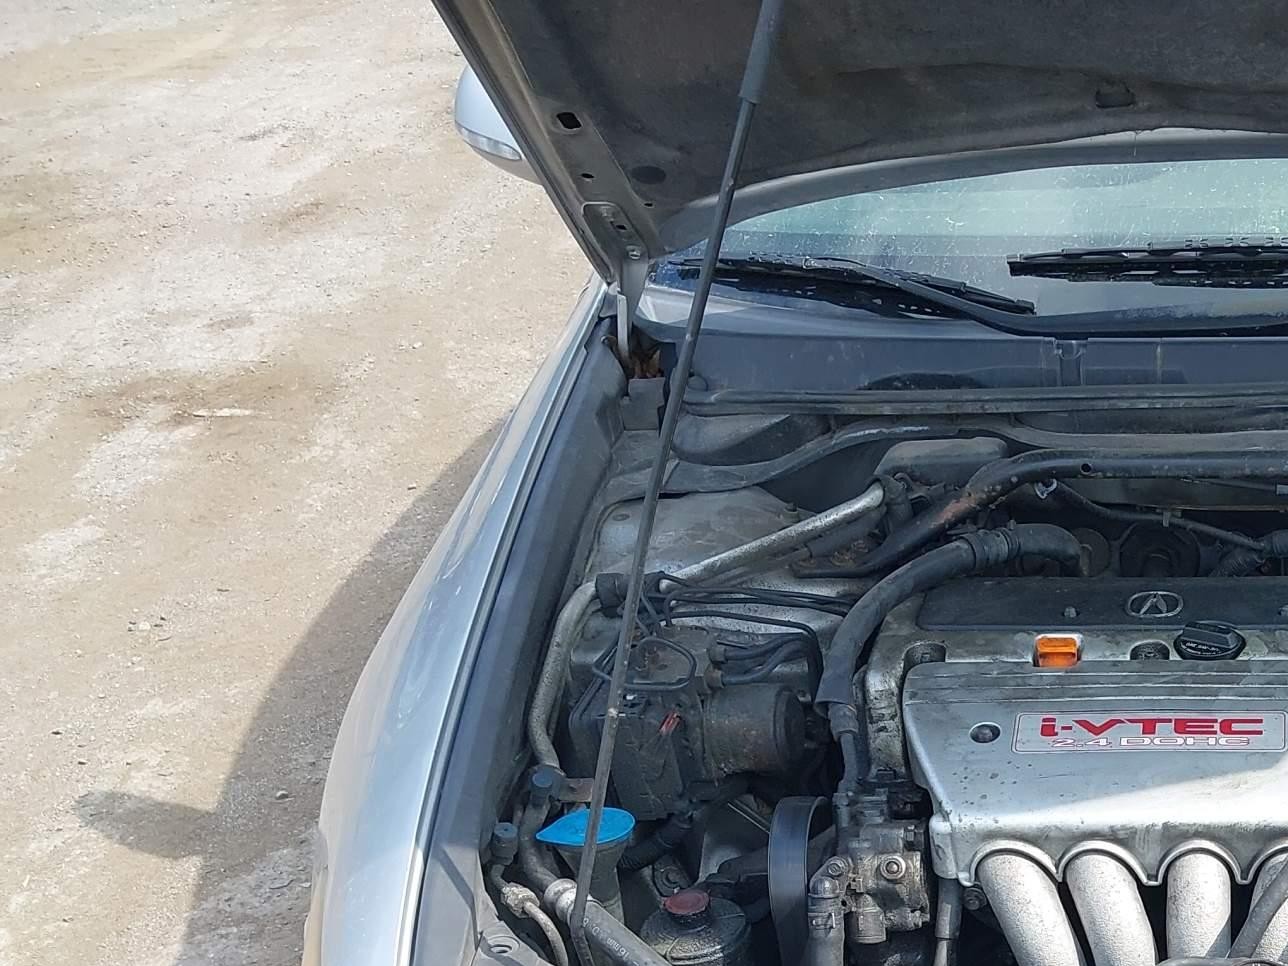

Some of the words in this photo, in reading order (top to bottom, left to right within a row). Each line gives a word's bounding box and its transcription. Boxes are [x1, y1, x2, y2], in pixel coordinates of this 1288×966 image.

[1040, 716, 1264, 737] i-VTEC
[1052, 737, 1111, 748] 2.4
[1118, 736, 1251, 747] DOHC
